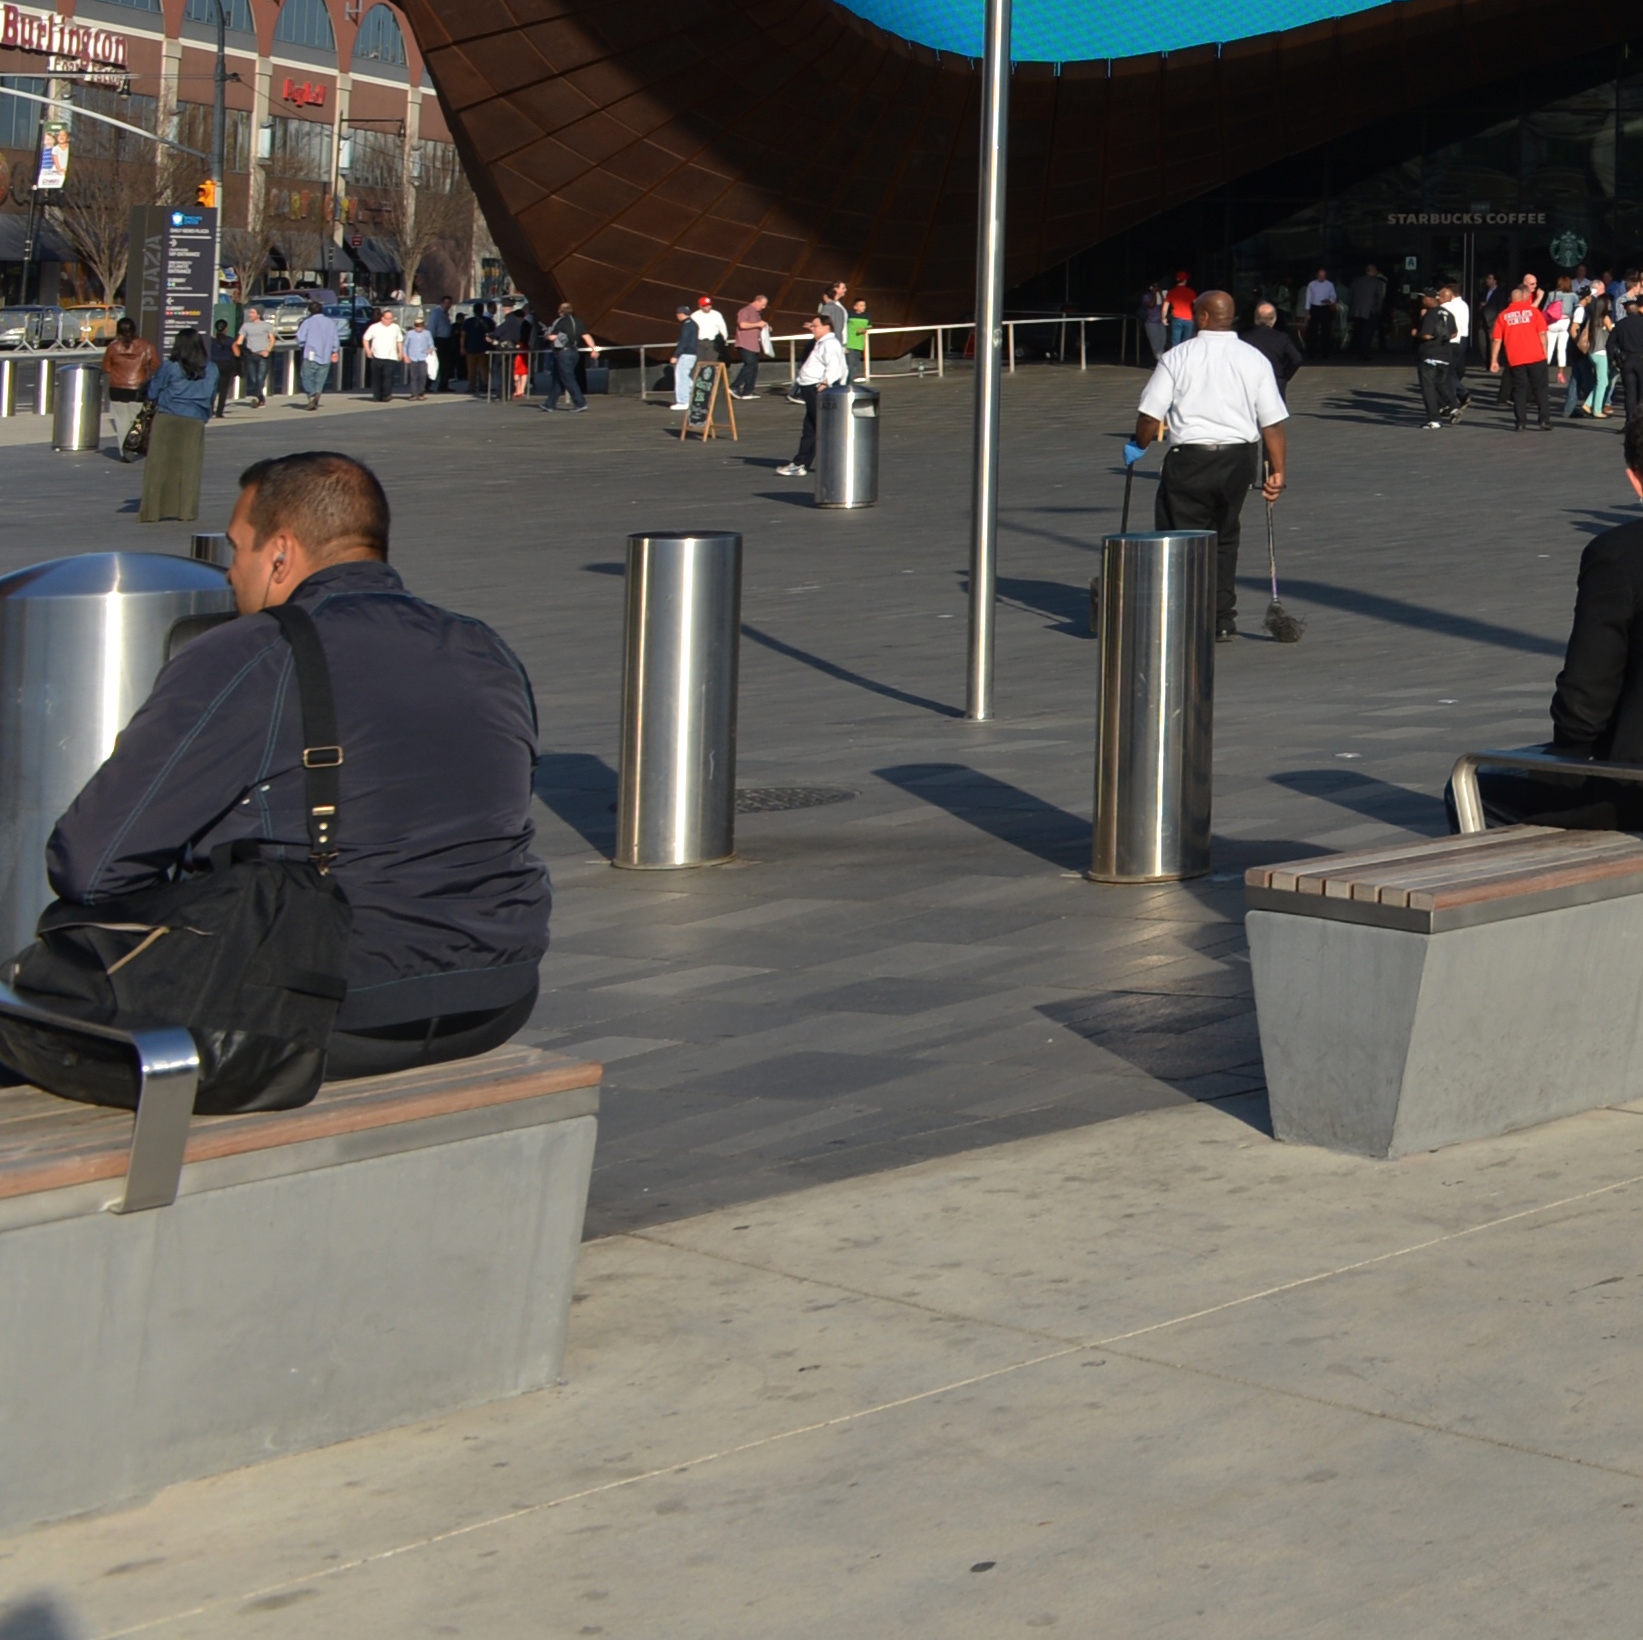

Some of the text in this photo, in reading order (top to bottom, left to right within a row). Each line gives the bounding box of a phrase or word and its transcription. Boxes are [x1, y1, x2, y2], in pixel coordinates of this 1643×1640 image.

[1, 3, 128, 67] Burlington
[1387, 213, 1546, 225] STARBUCKS COFFEE
[142, 234, 162, 312] PLAZA
